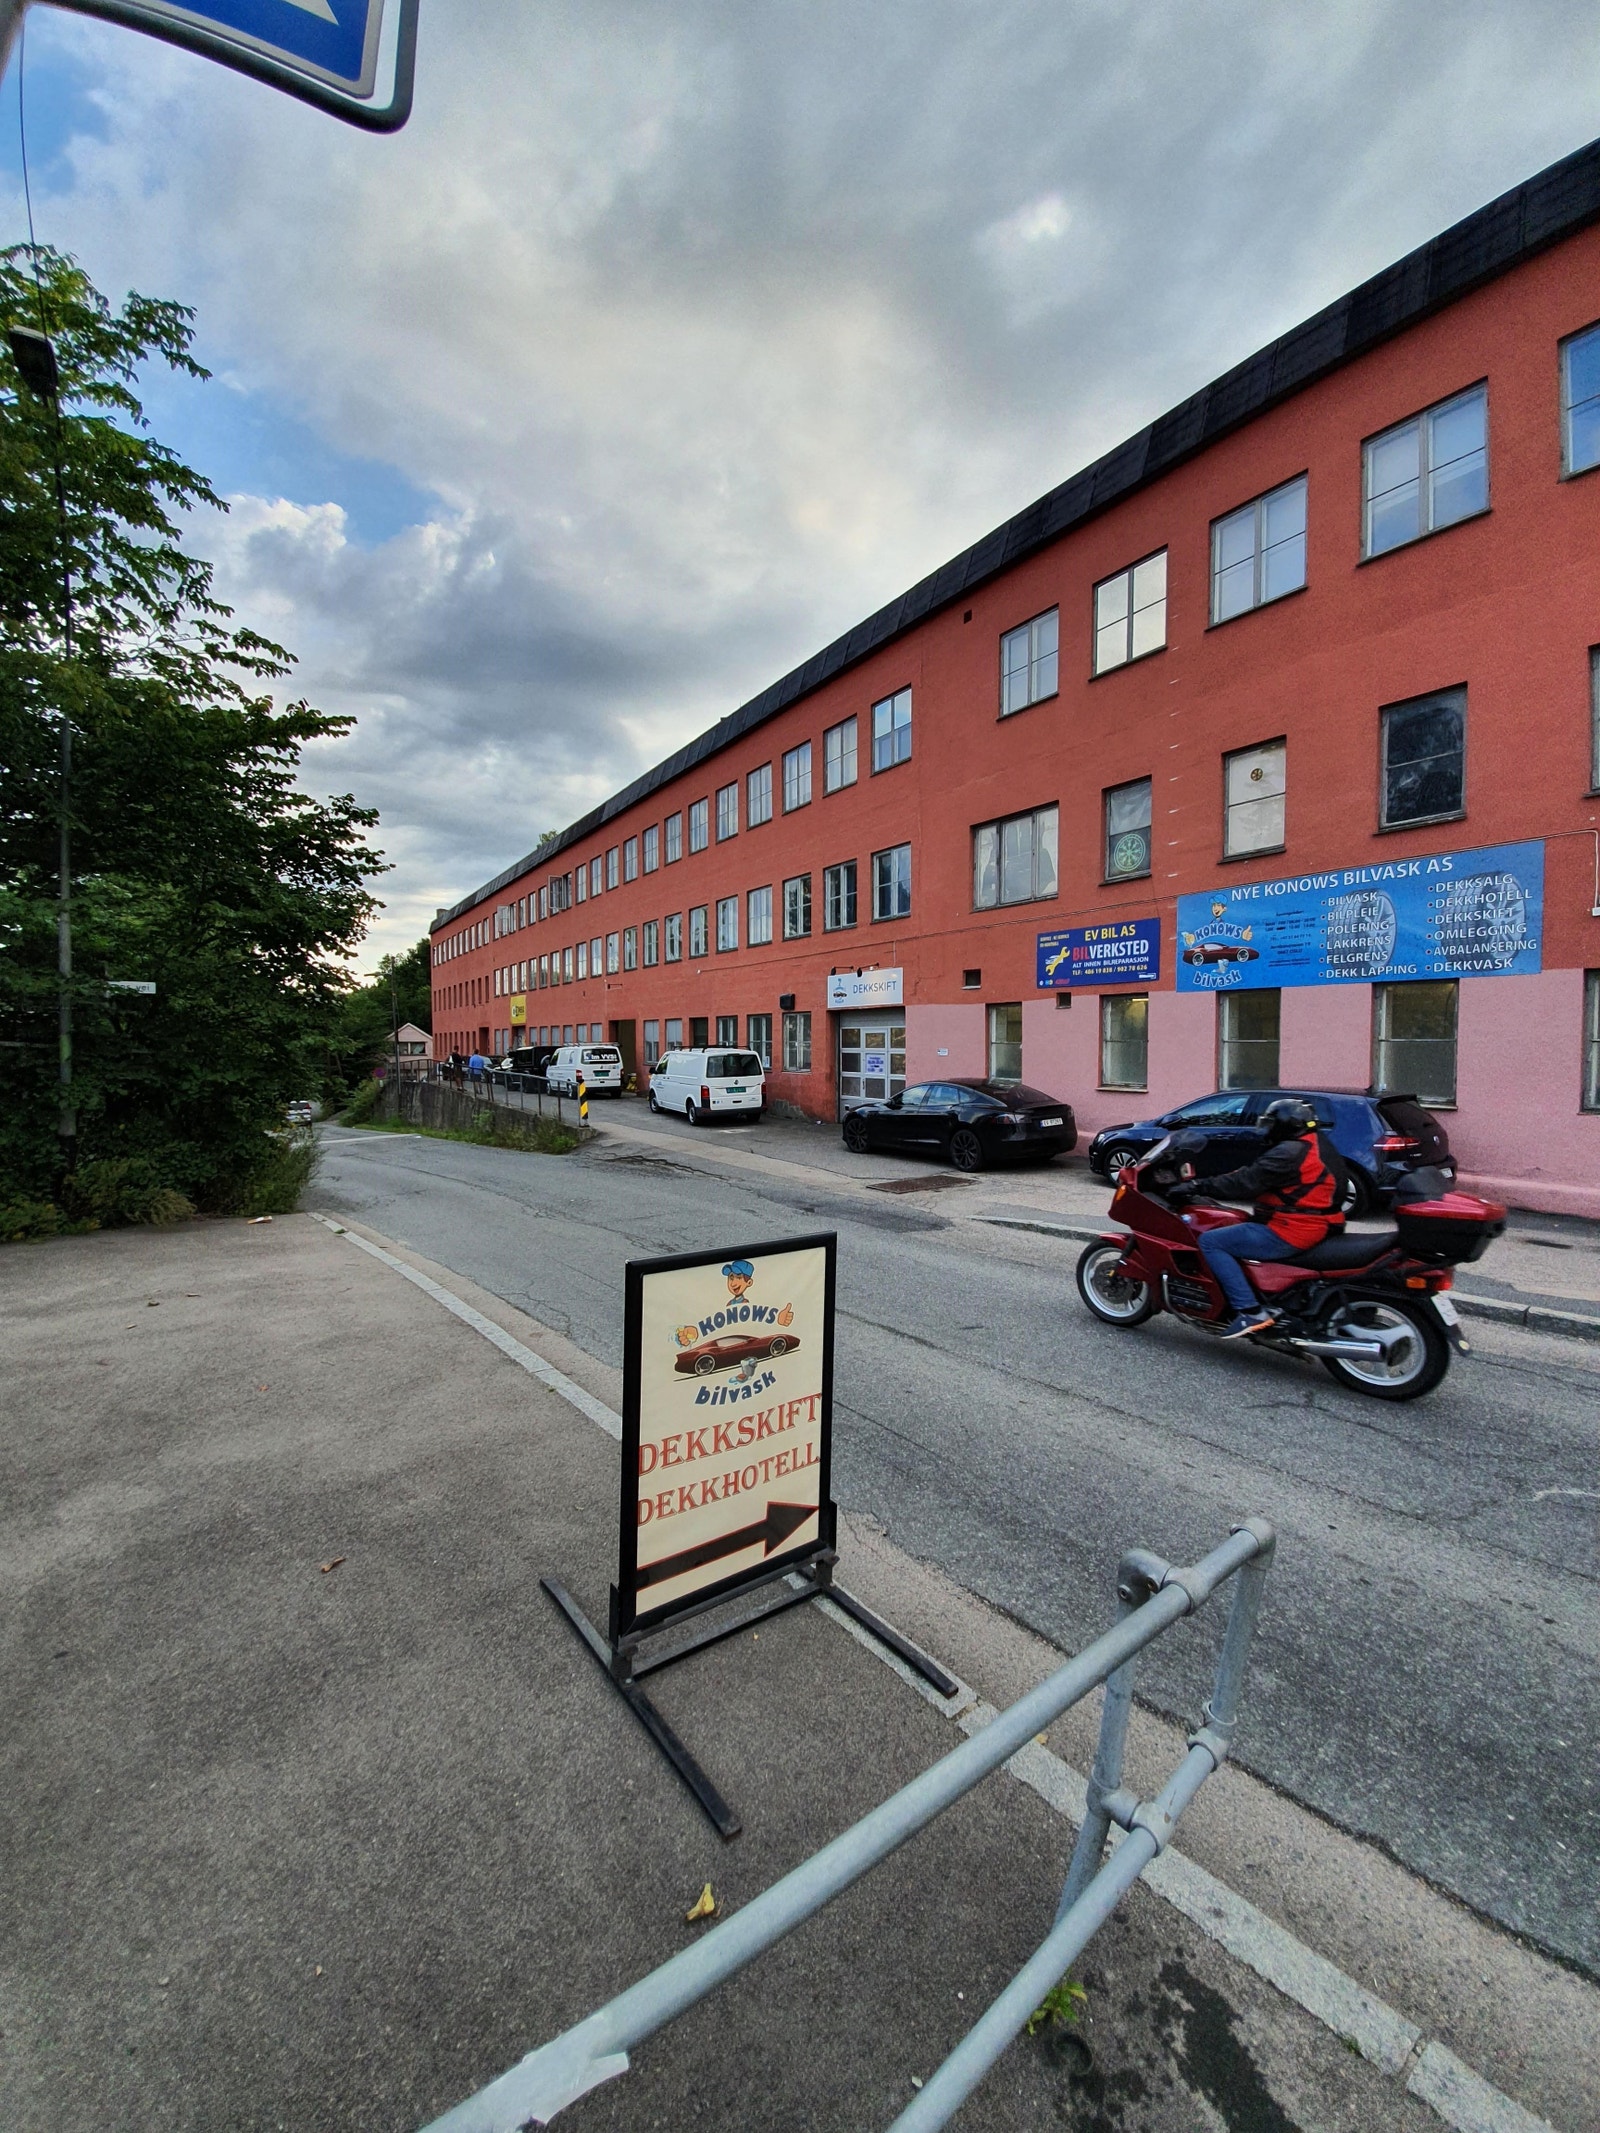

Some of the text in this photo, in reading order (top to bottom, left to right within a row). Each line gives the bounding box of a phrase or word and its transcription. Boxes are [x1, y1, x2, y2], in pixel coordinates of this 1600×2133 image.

[1231, 856, 1453, 901] NYE KONOWS BILVASK AS
[1435, 874, 1513, 893] DEKKSALG
[1328, 892, 1377, 906] BILVASK
[1435, 889, 1533, 909] DEKKHOTELL
[1327, 907, 1379, 921] BILPLEIE
[1434, 908, 1513, 925] DEKKSKIFT
[1085, 924, 1136, 941] EV BIL AS
[1194, 922, 1243, 941] KONOWS
[1327, 921, 1389, 935] POLERING
[1434, 923, 1527, 940] OMLEGGING
[1072, 939, 1149, 961] BILVERKSTED
[1326, 936, 1391, 950] LAKKRENS
[1433, 939, 1537, 956] AVBALANSERING
[1084, 960, 1101, 968] INNEN
[1103, 956, 1149, 966] BILREPARASJON
[1326, 951, 1388, 964] FELGRENS
[1433, 958, 1513, 972] DEKKVASK
[1193, 969, 1242, 987] bilvask
[1326, 964, 1417, 979] DEKK LAPPING
[852, 980, 897, 994] DEKKSKIFT
[698, 1305, 779, 1338] KONOWS
[694, 1370, 777, 1405] bilvask
[638, 1392, 822, 1477] DEKKSKIFT
[637, 1442, 820, 1527] DEKKHOTELL
